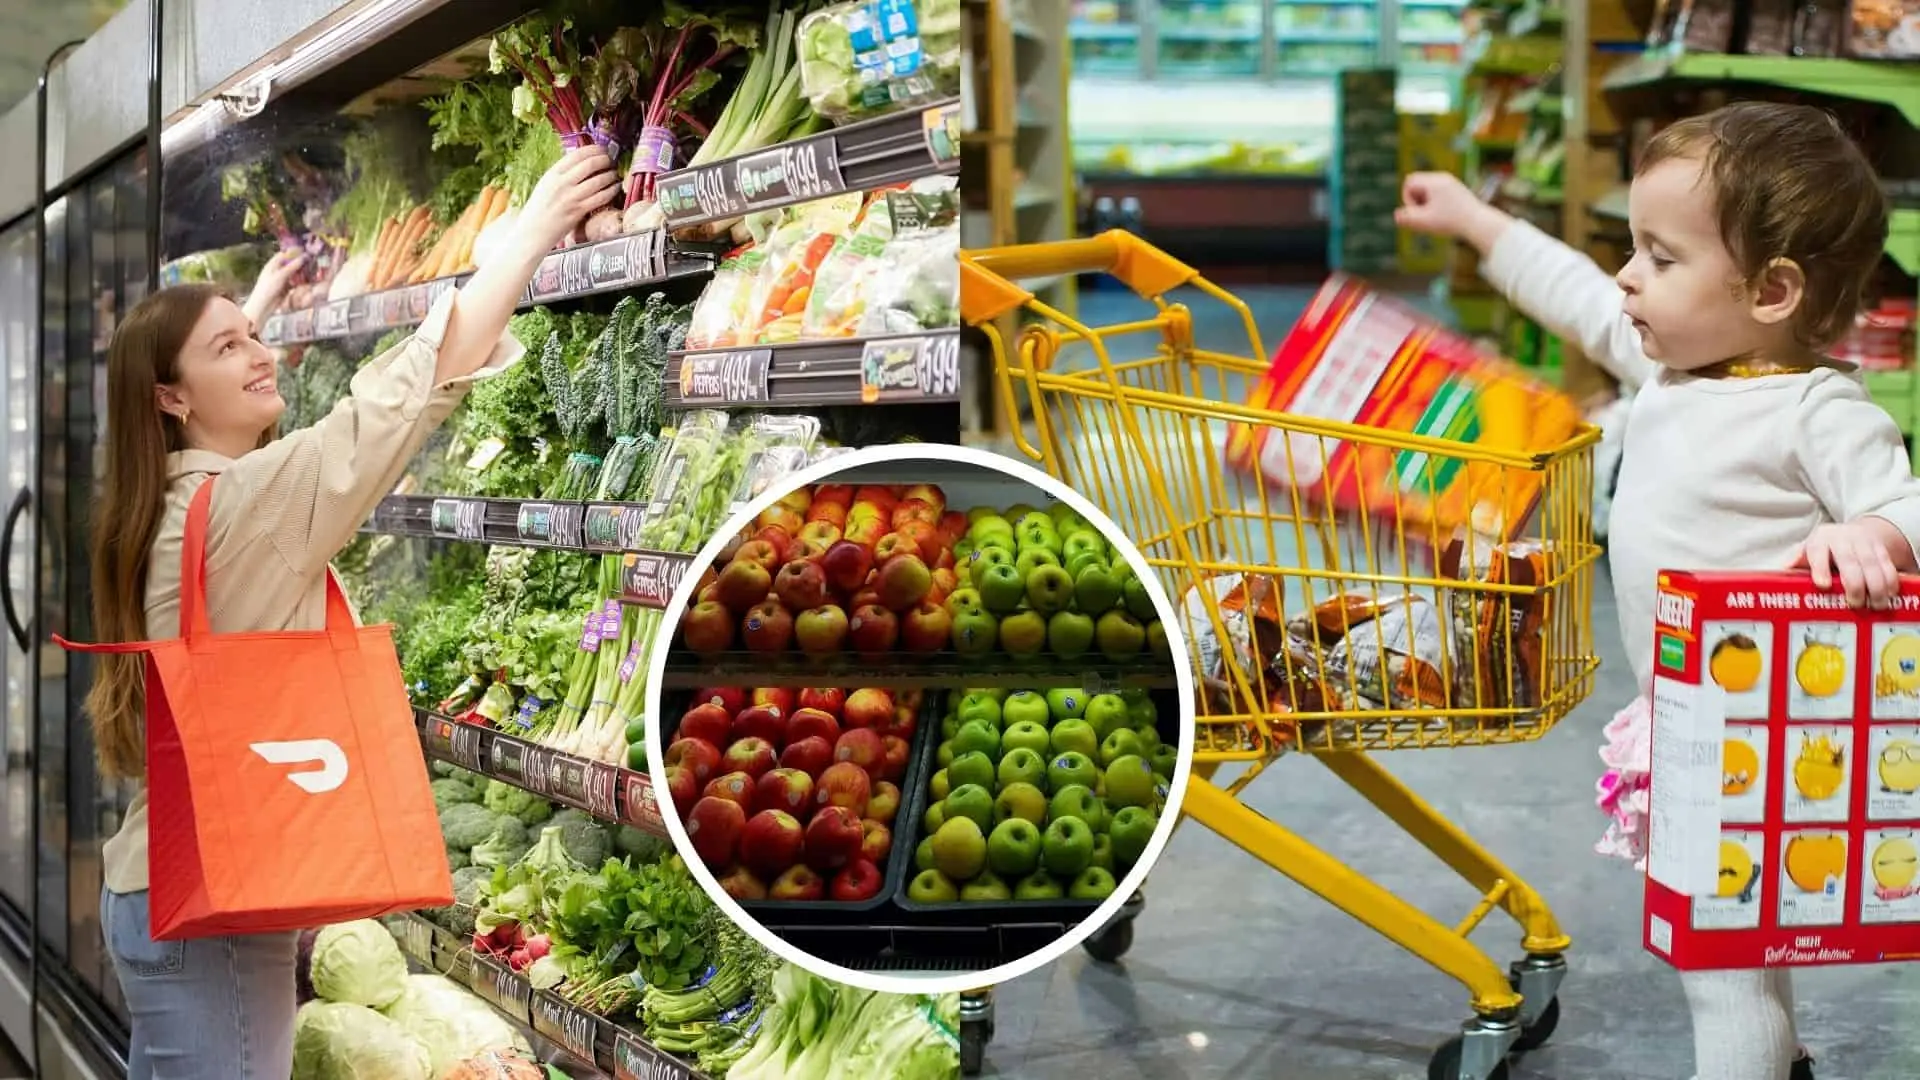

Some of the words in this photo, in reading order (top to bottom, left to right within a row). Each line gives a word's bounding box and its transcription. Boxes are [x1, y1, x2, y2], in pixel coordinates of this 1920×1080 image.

[723, 355, 751, 400] 499
[921, 336, 959, 393] 599
[1725, 592, 1755, 609] ARE
[1757, 592, 1800, 609] THESE
[543, 1001, 561, 1025] Mint
